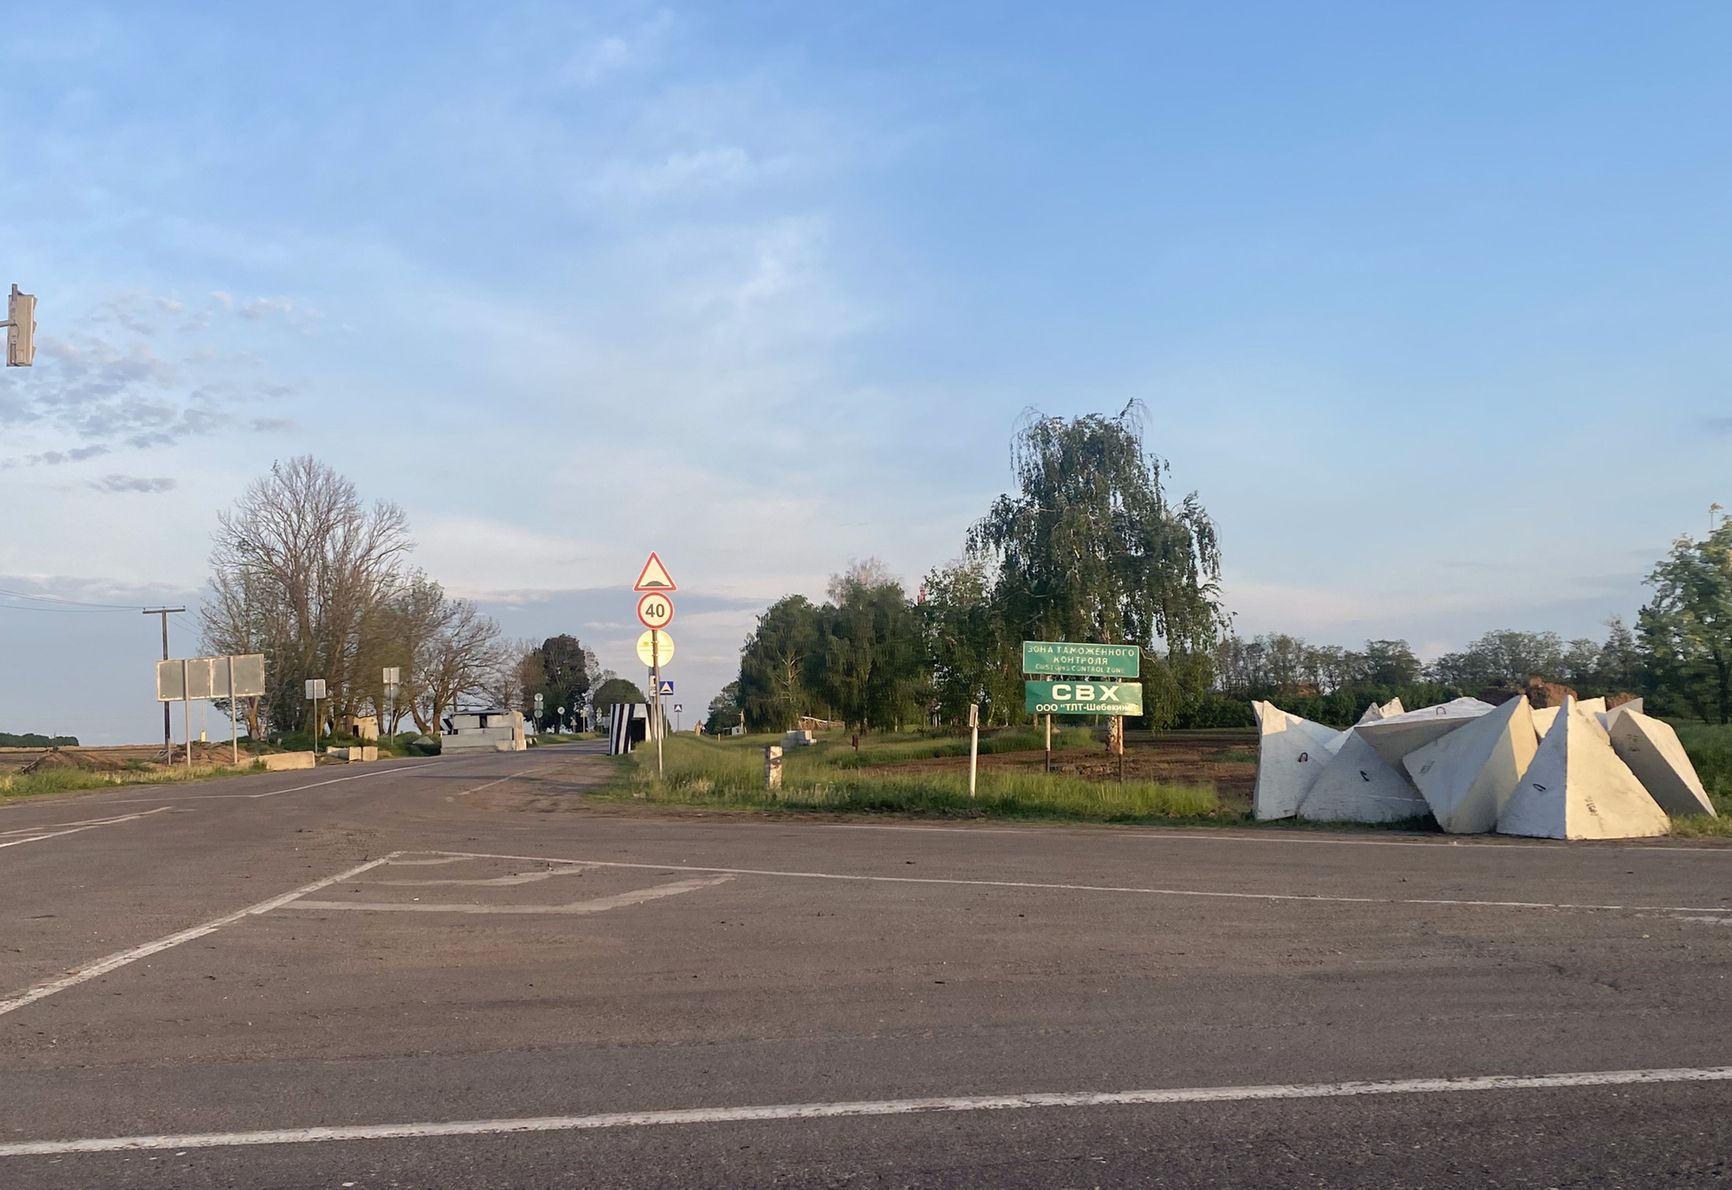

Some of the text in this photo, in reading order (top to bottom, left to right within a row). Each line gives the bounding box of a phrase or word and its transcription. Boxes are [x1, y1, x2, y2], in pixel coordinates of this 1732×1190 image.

[645, 603, 665, 617] 40
[1028, 645, 1134, 656] ЗОНА ТАМОЖЕННОГО
[1053, 656, 1108, 665] КОНТРОЛЯ
[1052, 684, 1120, 701] СВХ
[1035, 703, 1058, 712] ООО
